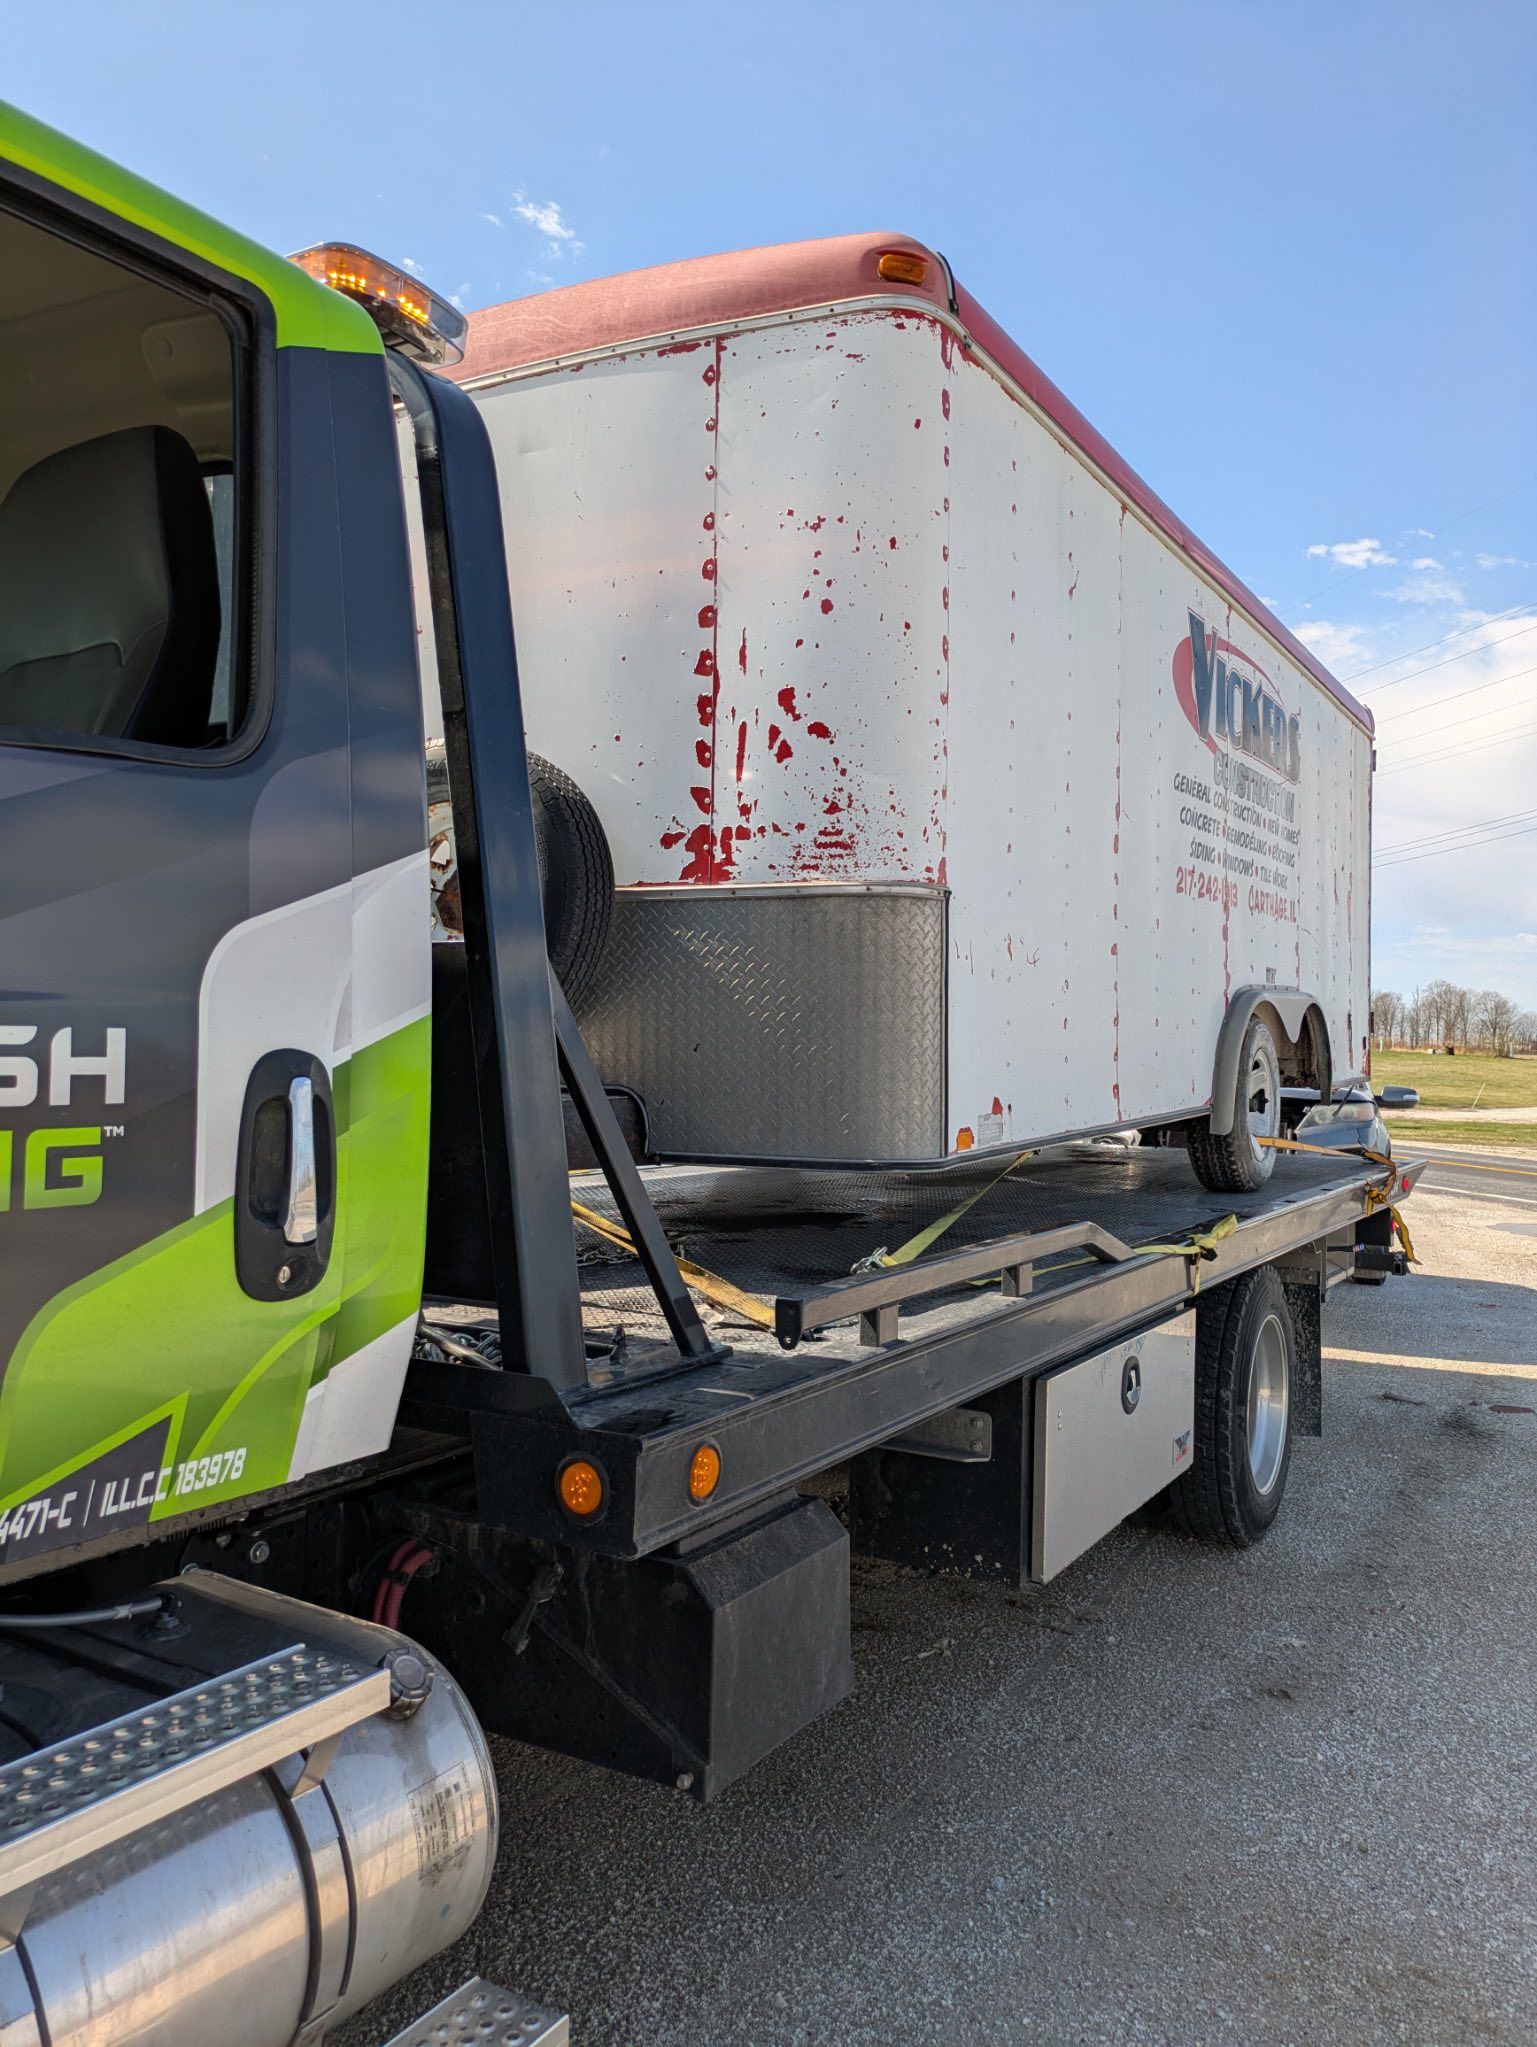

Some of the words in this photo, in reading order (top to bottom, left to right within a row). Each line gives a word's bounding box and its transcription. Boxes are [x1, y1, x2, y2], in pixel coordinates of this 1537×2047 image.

[1174, 773, 1211, 804] GENERAL
[1214, 790, 1262, 828] CONSTRUCTION
[1267, 819, 1280, 837] NEW
[1180, 806, 1220, 838] CONCRETE
[1226, 826, 1268, 857] REMODELING
[1271, 845, 1296, 868] ROOFING
[1190, 839, 1216, 865] SIDING
[1222, 850, 1255, 878] WINDOWS
[1260, 866, 1272, 884] TILE
[1272, 869, 1289, 891] WORK
[0, 1127, 104, 1212] G
[0, 1491, 78, 1545] 4471-C
[175, 1448, 247, 1496] 183978
